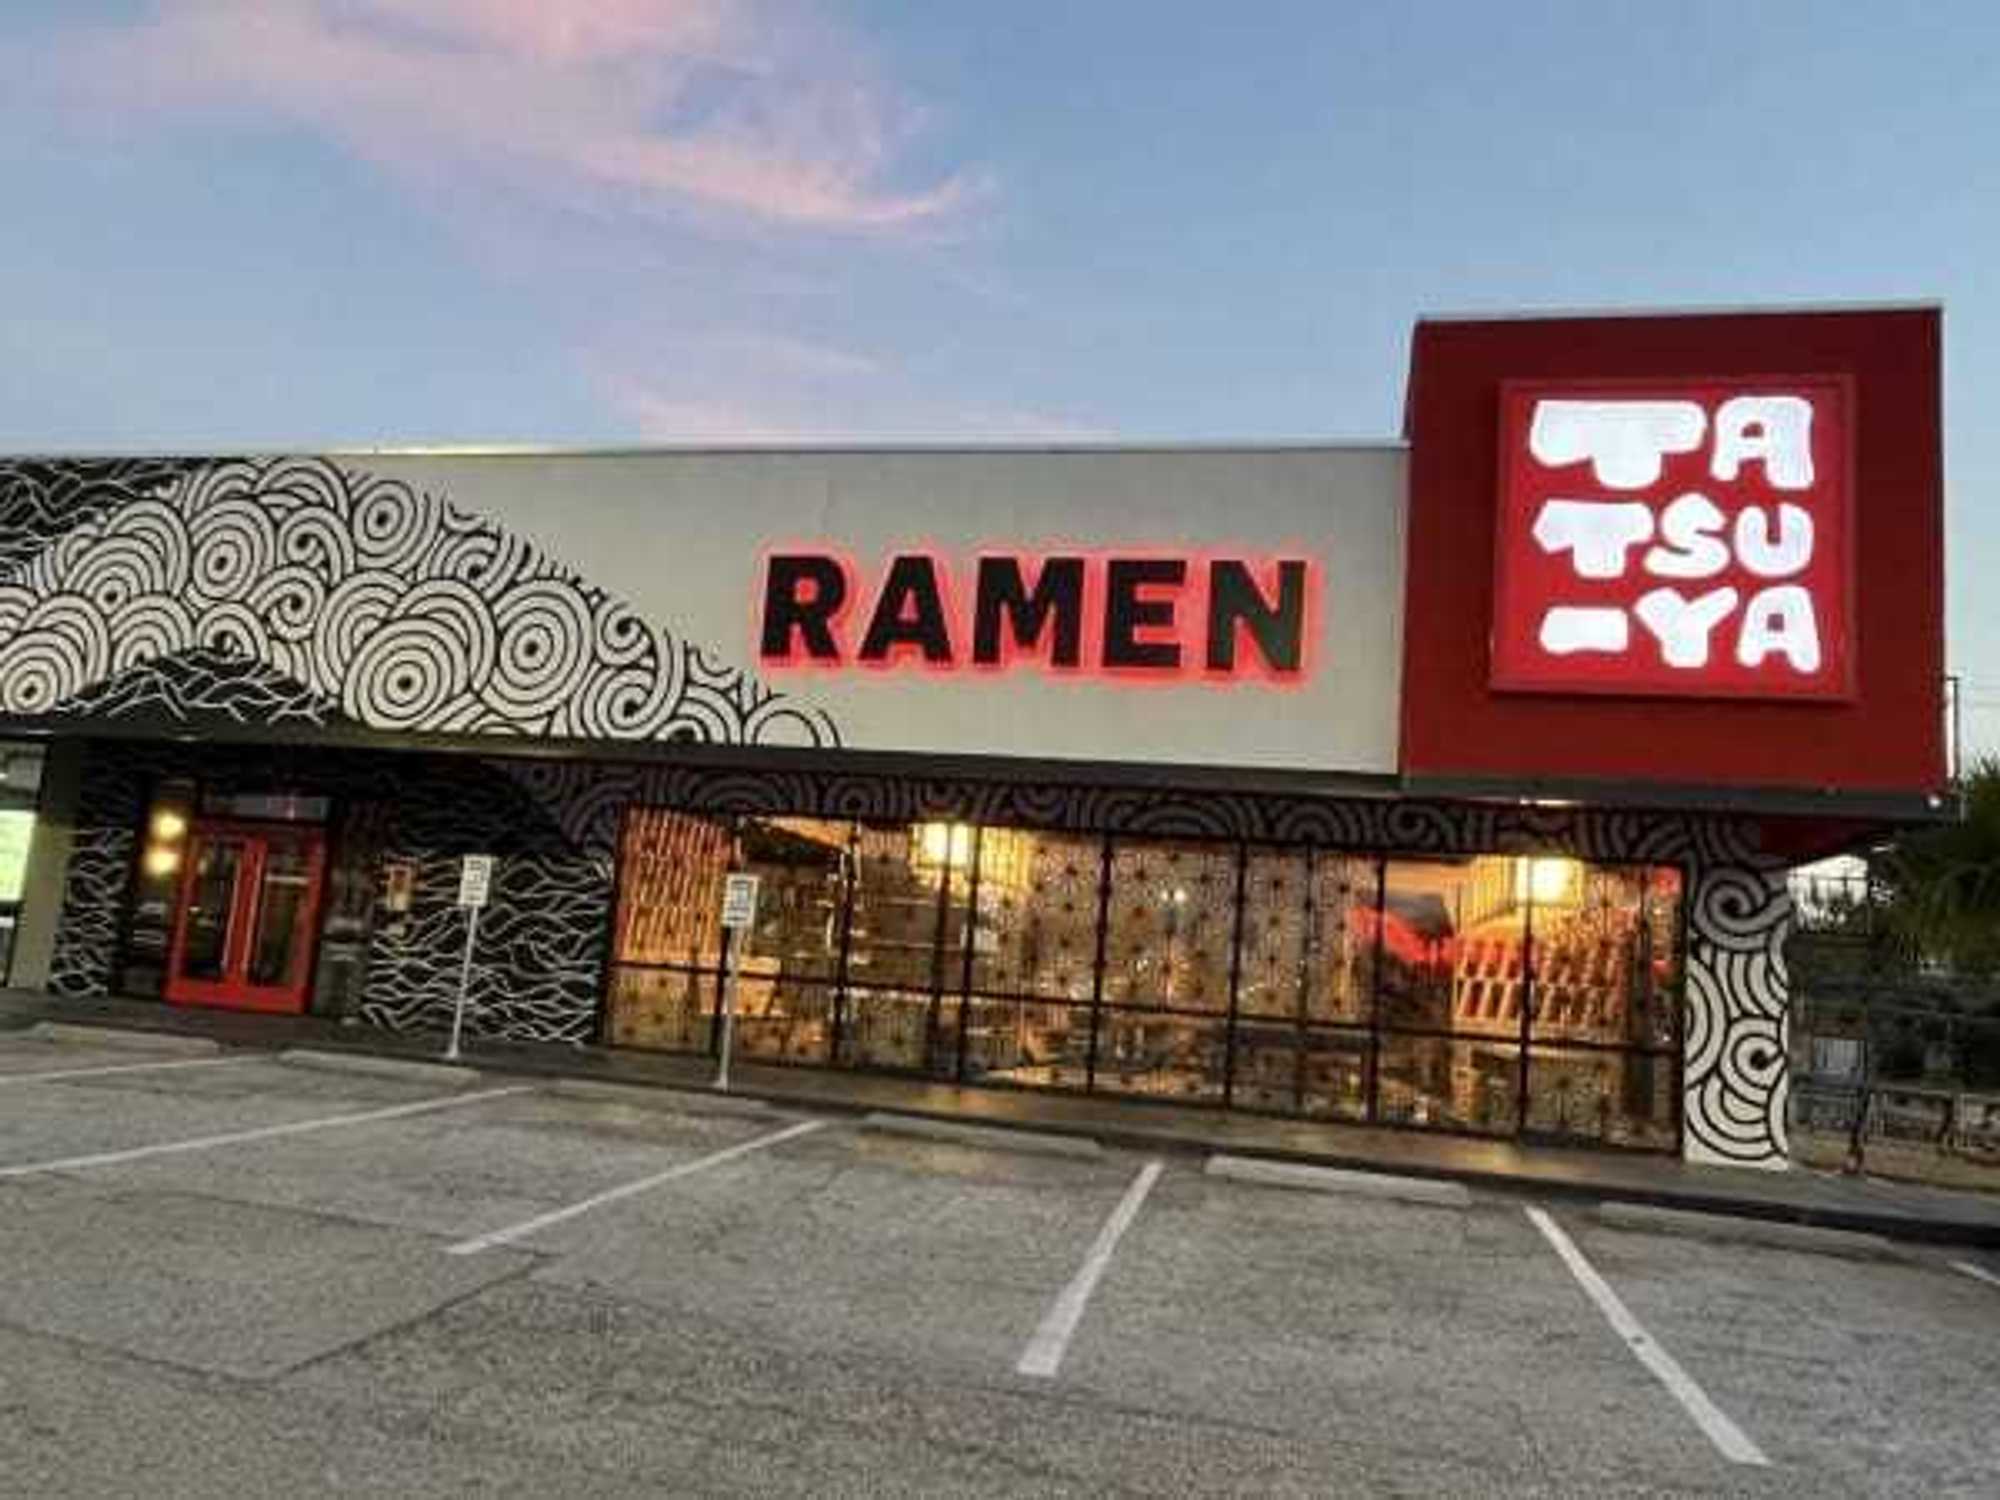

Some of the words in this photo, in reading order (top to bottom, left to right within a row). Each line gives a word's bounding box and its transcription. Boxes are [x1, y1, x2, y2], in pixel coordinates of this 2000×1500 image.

[1529, 395, 1815, 490] TA
[1531, 493, 1814, 578] TSU
[760, 555, 1307, 671] RAMEN
